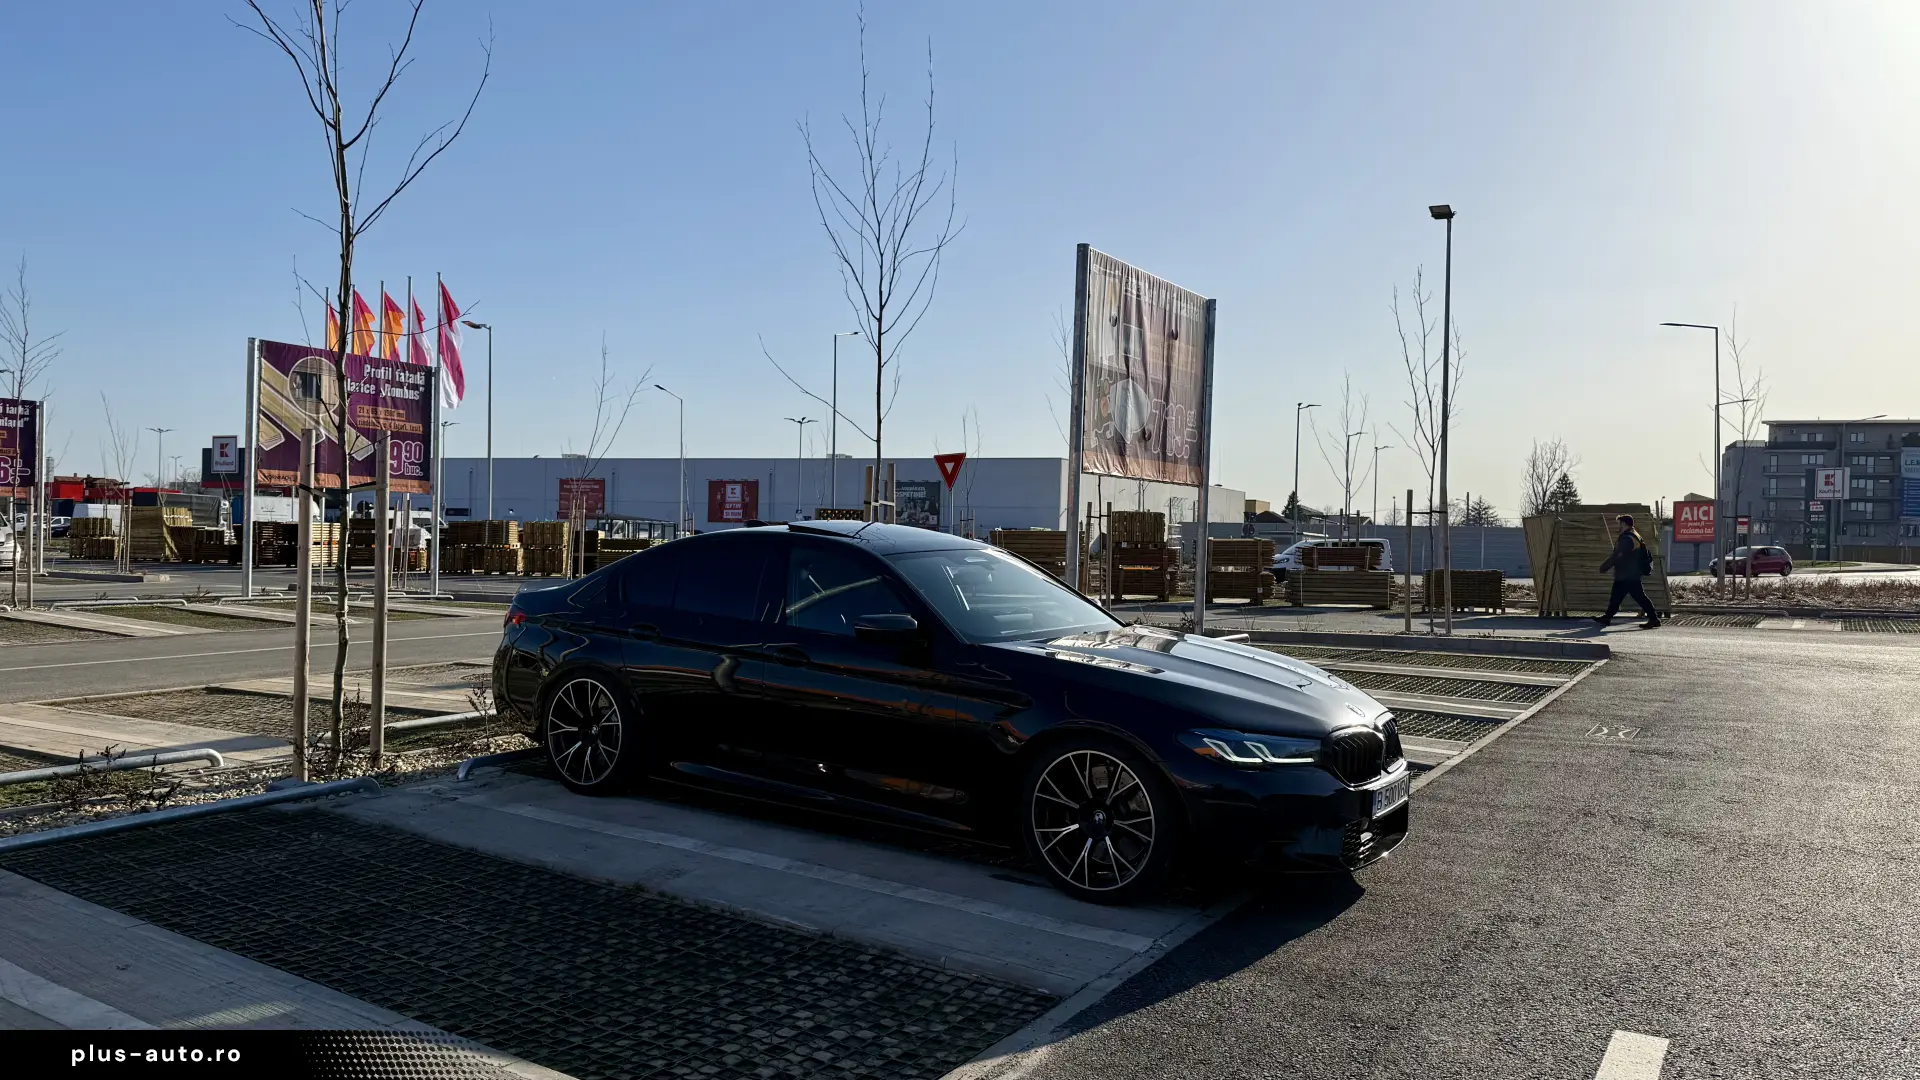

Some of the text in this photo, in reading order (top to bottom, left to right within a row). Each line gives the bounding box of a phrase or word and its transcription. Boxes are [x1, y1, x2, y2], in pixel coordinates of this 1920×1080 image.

[364, 364, 392, 380] Profil
[347, 378, 376, 394] larice
[405, 463, 424, 476] buc.
[1681, 505, 1714, 521] AICI
